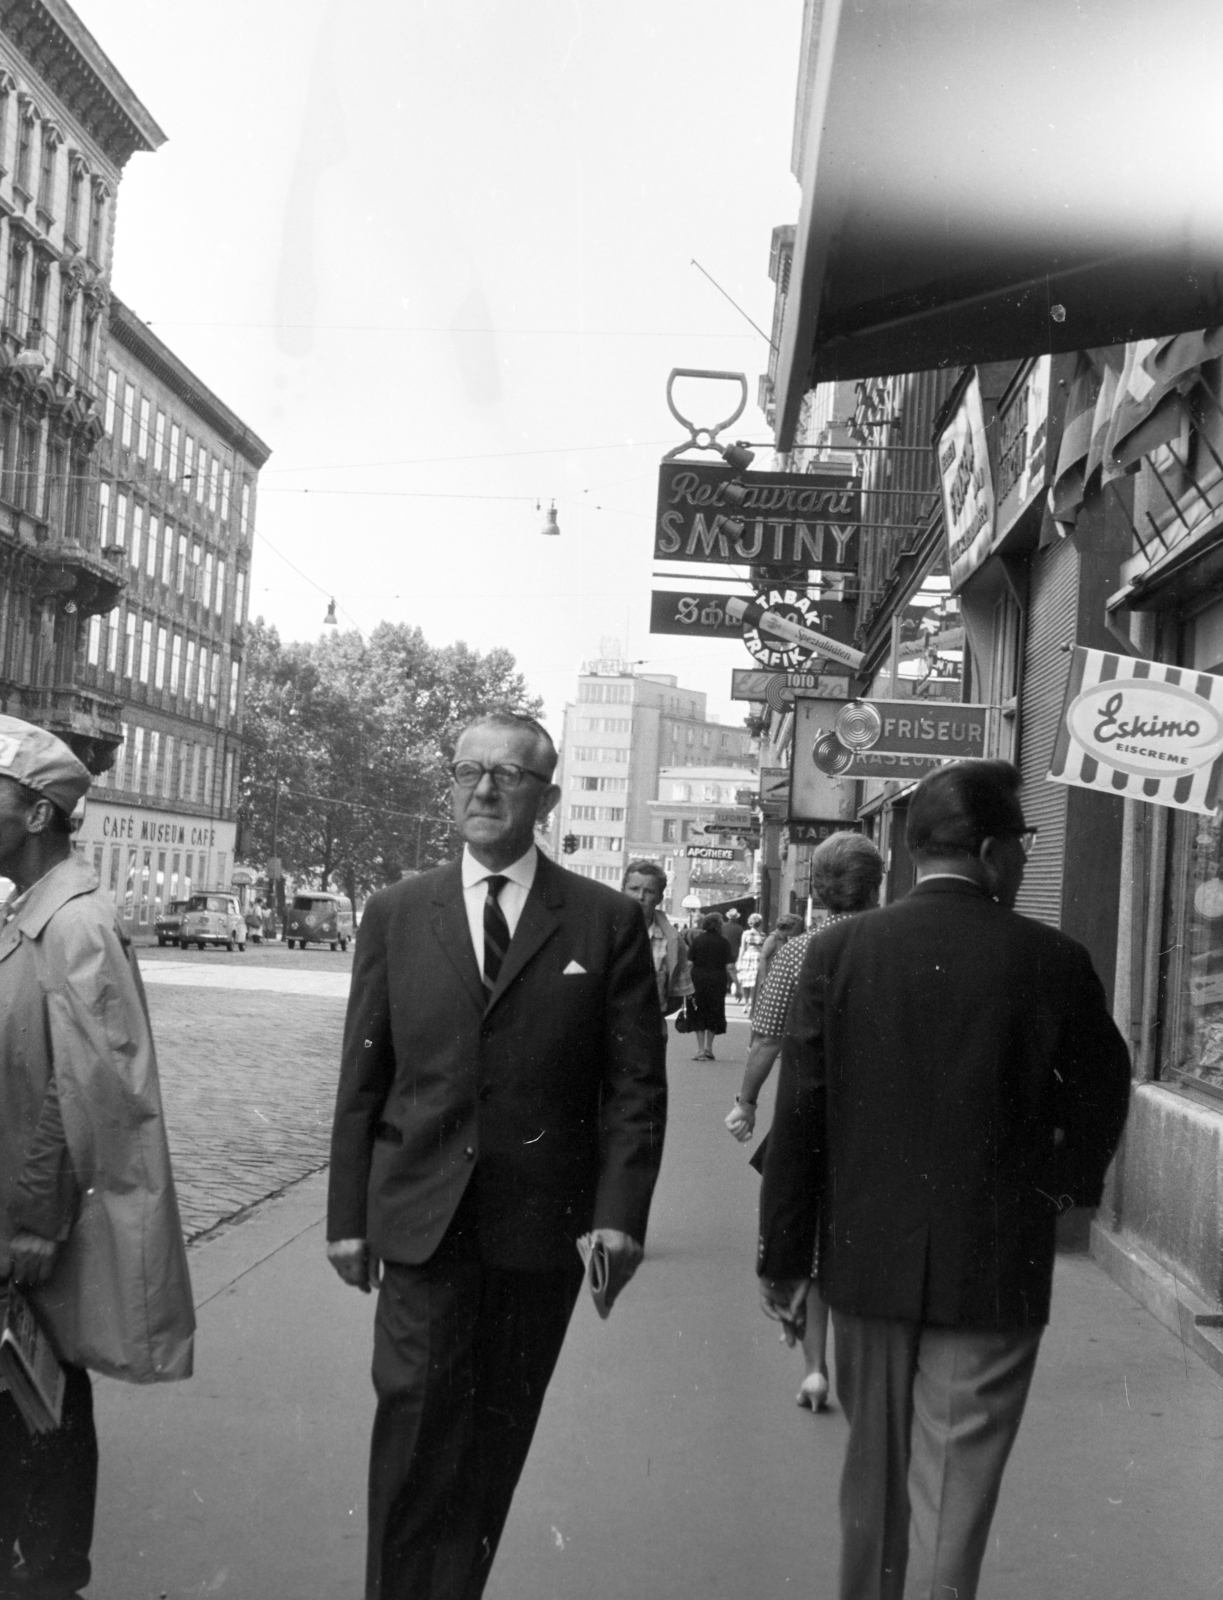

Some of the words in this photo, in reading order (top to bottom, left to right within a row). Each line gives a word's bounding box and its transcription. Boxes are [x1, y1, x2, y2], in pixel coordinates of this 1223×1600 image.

[670, 472, 854, 513] Resaurant
[659, 512, 857, 563] SMUTNY
[755, 589, 820, 627] TABAK
[743, 629, 806, 667] TRAFIK
[786, 673, 815, 688] TOTO
[884, 718, 983, 743] FRISEUR
[1094, 692, 1200, 743] Eskimo
[1116, 743, 1189, 765] EISCREME
[103, 815, 134, 838] CAFÉ
[140, 821, 185, 845] MUSEUM
[717, 813, 748, 823] ILFORD
[687, 847, 734, 860] APOTHEKE
